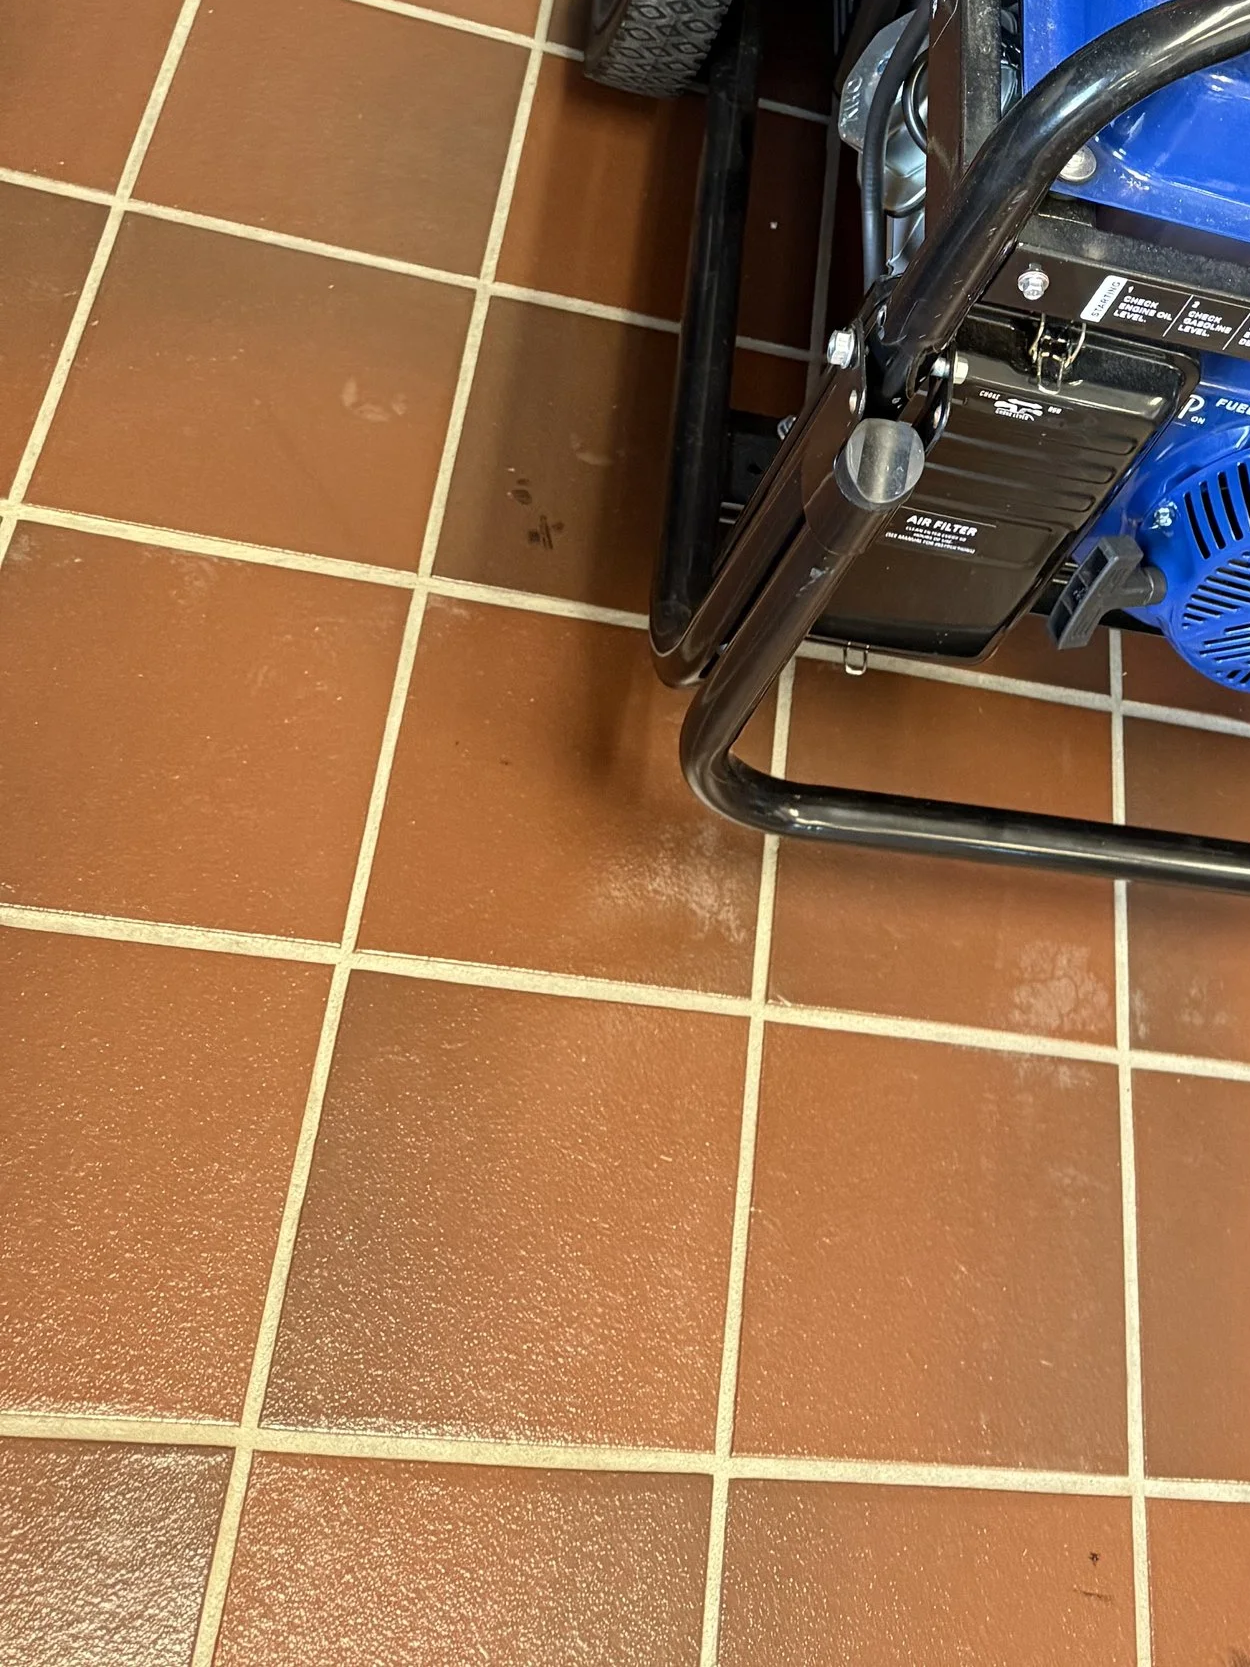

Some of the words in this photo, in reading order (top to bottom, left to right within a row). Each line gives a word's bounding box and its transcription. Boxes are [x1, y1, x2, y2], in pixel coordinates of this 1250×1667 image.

[1090, 281, 1121, 317] STARTING
[1123, 295, 1160, 309] CHECK
[1114, 310, 1147, 323] LEVEL.
[1118, 302, 1156, 317] ENGINE
[1157, 311, 1173, 321] OIL
[1188, 310, 1222, 323] CHECK
[1178, 325, 1210, 337] LEVEL.
[1183, 317, 1232, 334] GASOLINE
[1190, 416, 1205, 424] ON
[907, 515, 932, 527] AIR
[933, 520, 977, 537] FILTER
